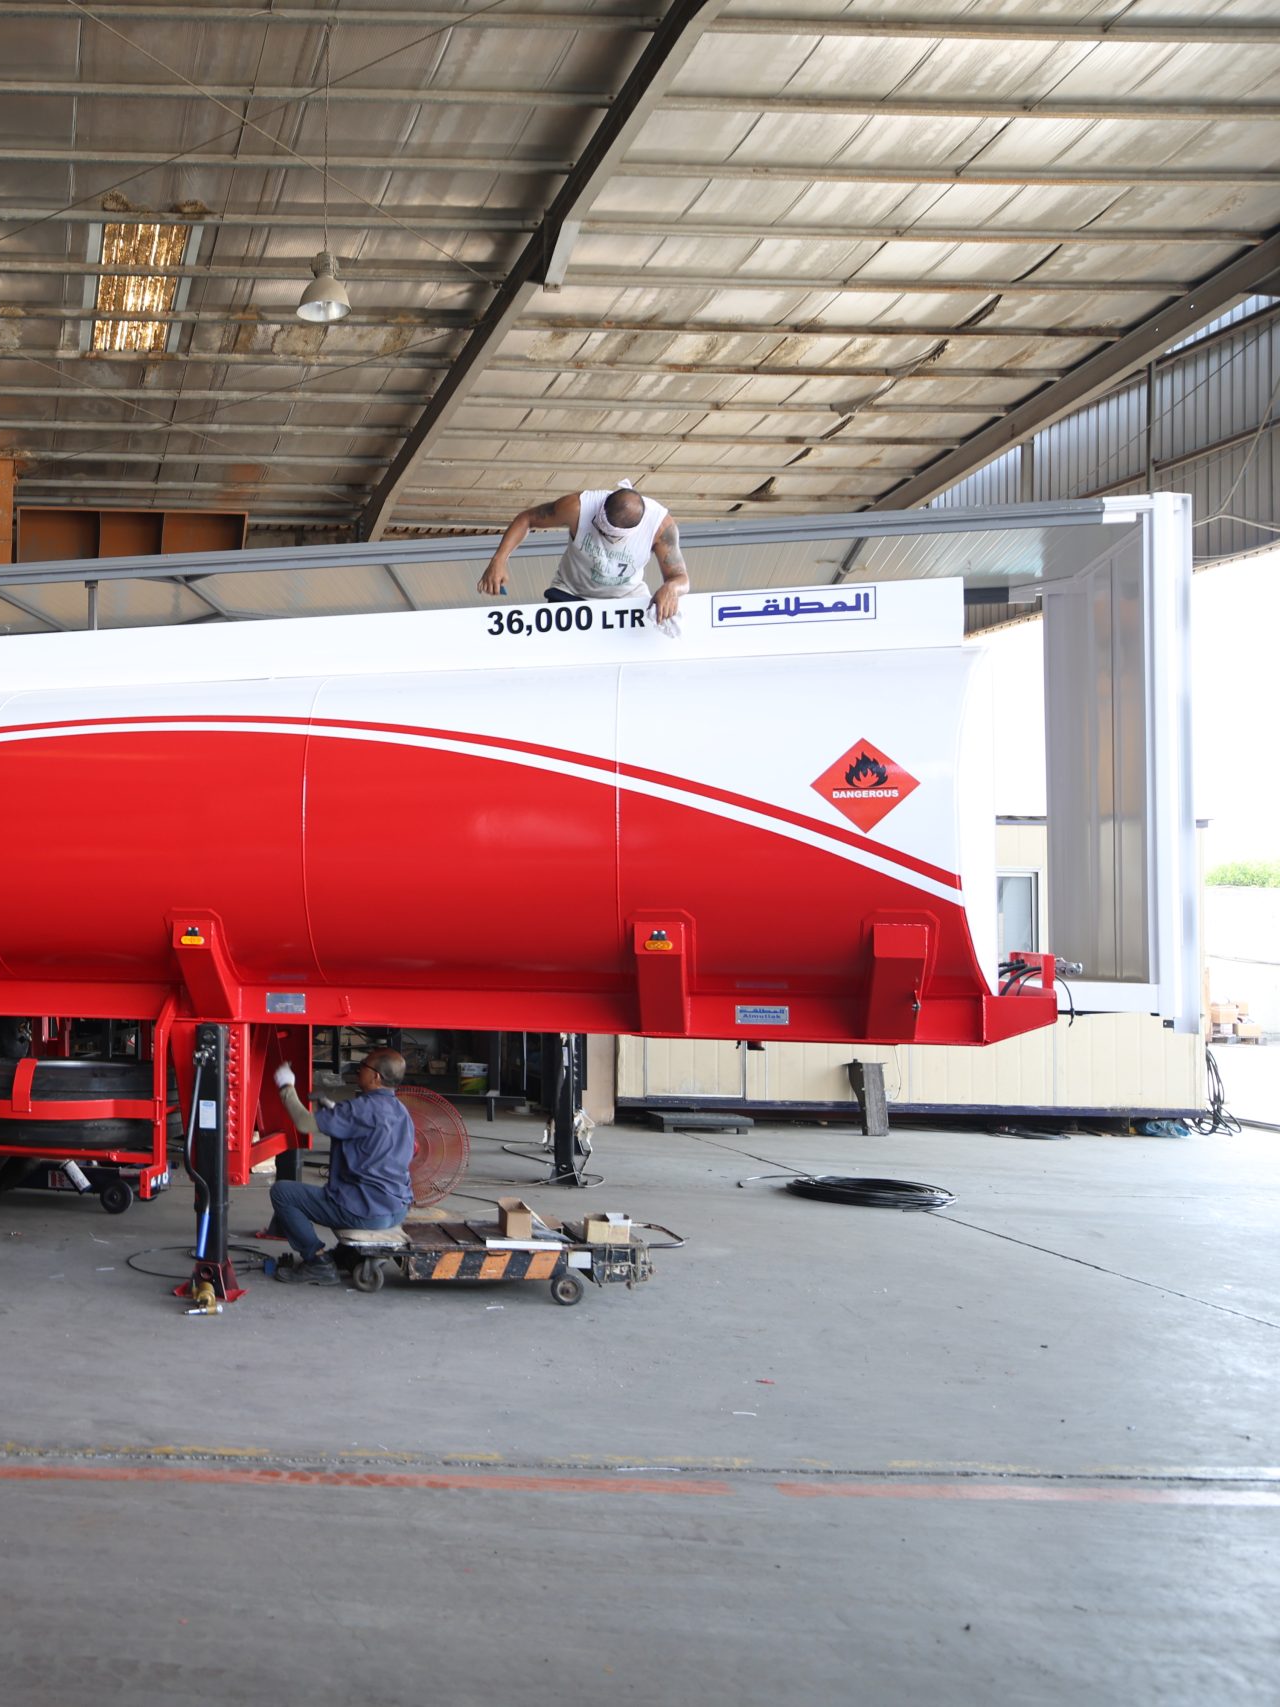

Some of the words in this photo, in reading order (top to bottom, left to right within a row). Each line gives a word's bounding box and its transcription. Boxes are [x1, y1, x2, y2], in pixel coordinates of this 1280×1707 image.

[617, 562, 629, 577] 7
[487, 605, 593, 636] 36,000
[601, 608, 646, 630] LTR
[832, 789, 899, 799] DANGEROUS
